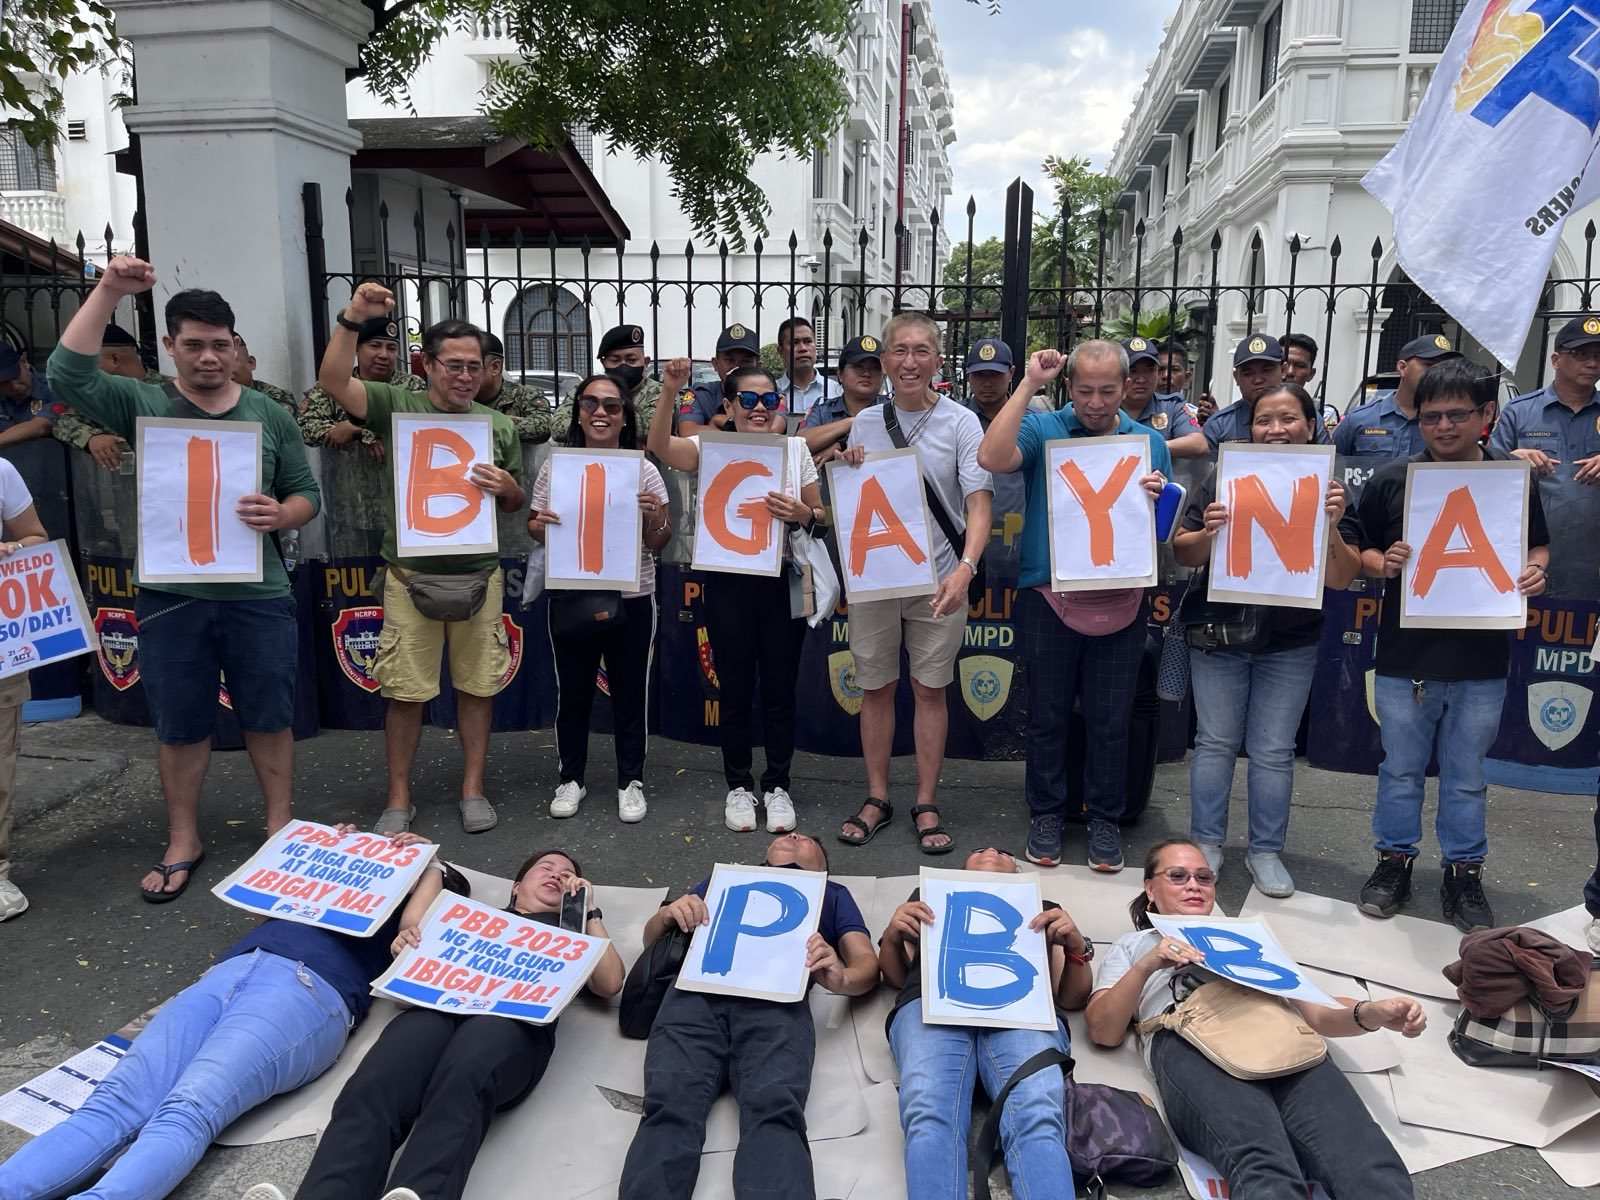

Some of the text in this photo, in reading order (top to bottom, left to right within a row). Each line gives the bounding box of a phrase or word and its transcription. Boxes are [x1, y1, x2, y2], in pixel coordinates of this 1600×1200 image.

[186, 435, 220, 566] I
[407, 428, 484, 536] B
[703, 460, 773, 555] G
[1056, 455, 1141, 567] Y
[578, 463, 606, 574] I
[849, 475, 927, 577] A
[1226, 473, 1320, 581] N
[1409, 485, 1516, 599] A
[0, 553, 53, 577] WELDO
[88, 565, 139, 598] PULI
[965, 626, 1013, 647] MPD
[1536, 648, 1595, 673] MPD
[244, 869, 335, 902] IBIGAY
[331, 890, 386, 914] NA!
[279, 858, 374, 892] AT KAWANI,
[281, 843, 395, 880] NG MGA GURO
[439, 928, 566, 973] NG MGA GURO
[440, 903, 589, 961] PBB 2023
[702, 881, 809, 976] P
[938, 891, 1038, 1010] B
[1178, 927, 1301, 991] B
[403, 957, 560, 1003] IBIGAY NA!
[439, 946, 542, 984] AT KAWANI,
